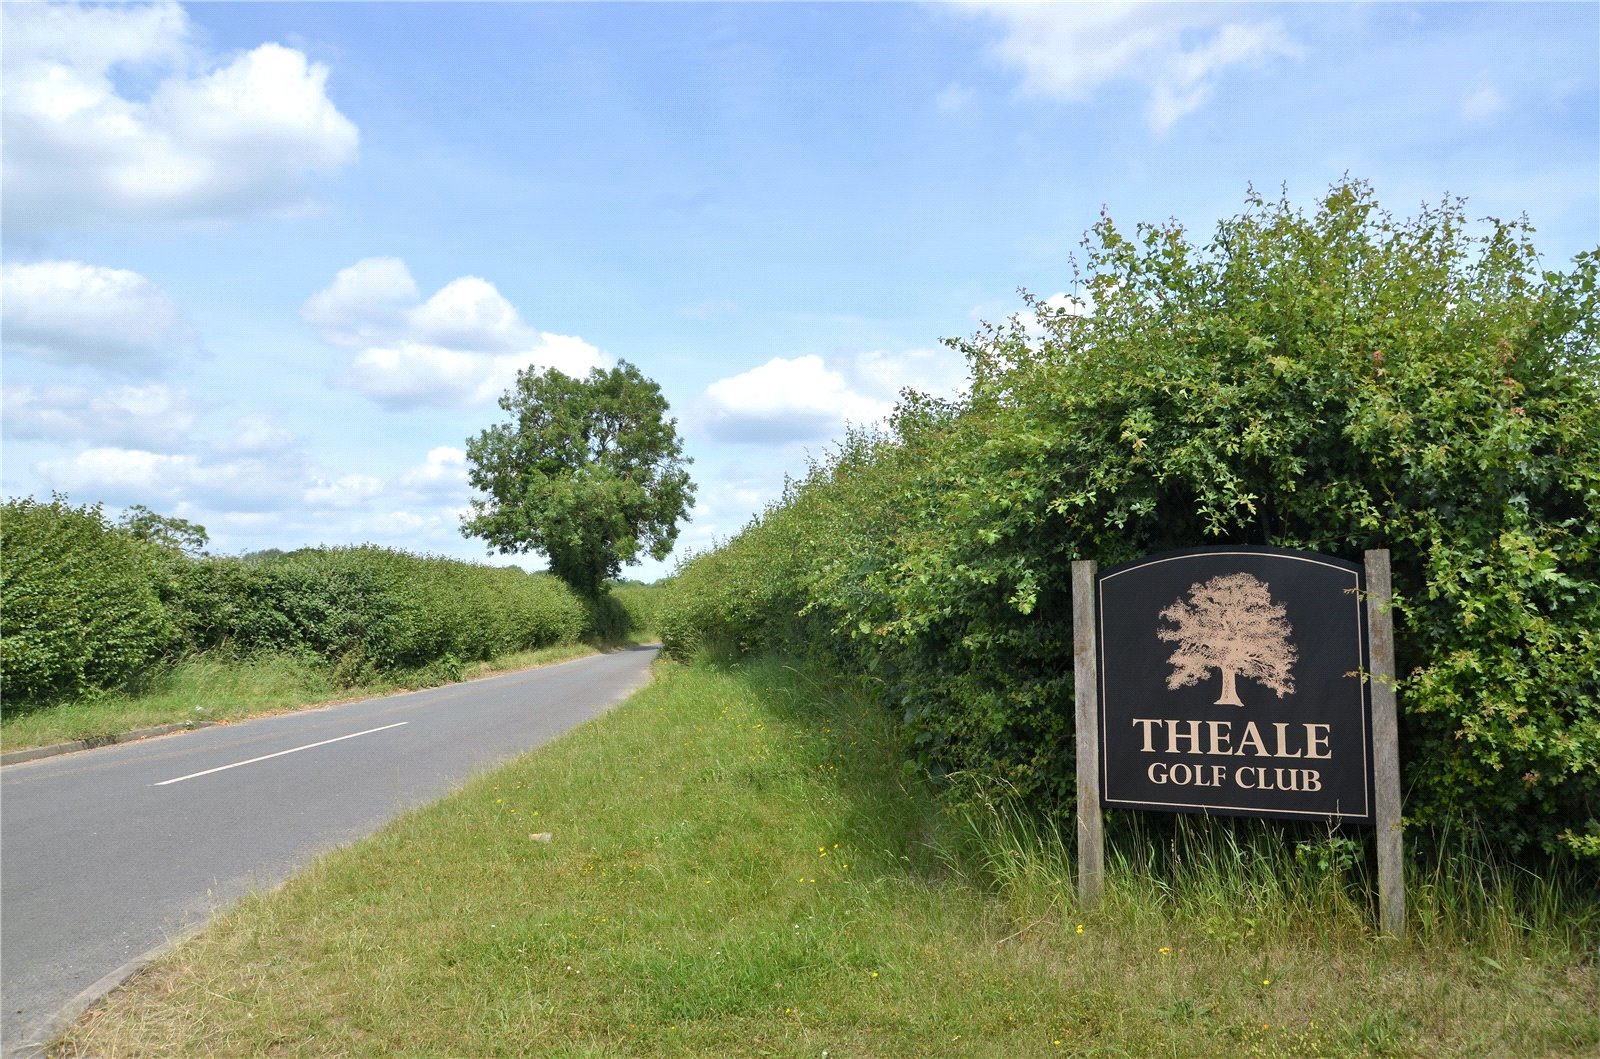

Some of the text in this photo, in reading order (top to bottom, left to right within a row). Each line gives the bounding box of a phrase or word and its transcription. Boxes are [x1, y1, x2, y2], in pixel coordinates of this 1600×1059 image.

[1132, 718, 1332, 759] THEALE
[1147, 762, 1322, 792] GOLF CLUB
